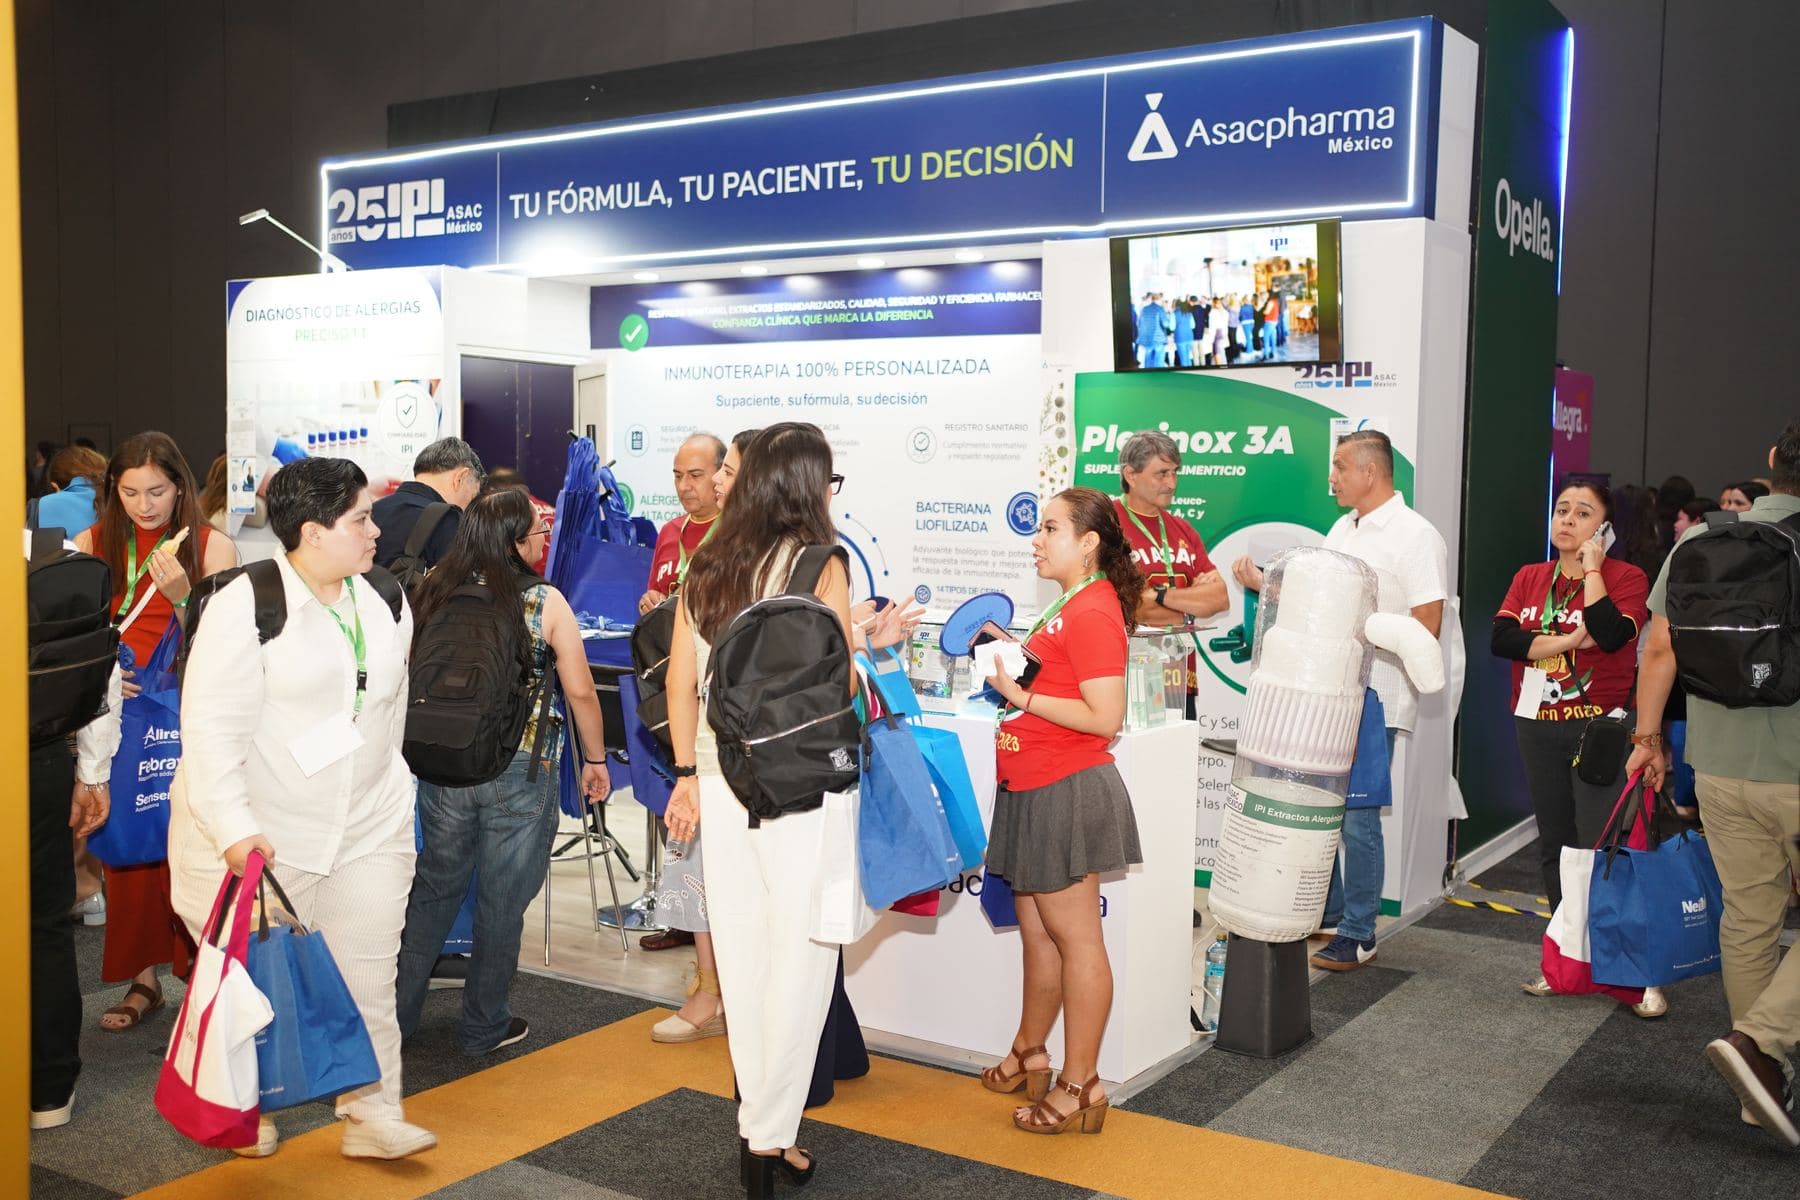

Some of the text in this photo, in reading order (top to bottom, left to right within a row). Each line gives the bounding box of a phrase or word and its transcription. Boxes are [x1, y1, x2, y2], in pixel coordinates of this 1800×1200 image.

[1185, 105, 1396, 149] Asacpharma
[1328, 135, 1394, 155] México
[509, 132, 1074, 220] TU FÓRMULA, TU PACIENTE, TU DECISIÓN
[446, 203, 483, 220] ASAC
[446, 220, 483, 235] México
[939, 295, 946, 304] Y
[335, 304, 351, 318] DE
[354, 299, 422, 315] ALERGIAS
[803, 313, 823, 326] QUE
[824, 310, 859, 324] MARCA
[860, 311, 874, 322] LA
[875, 309, 934, 321] DIFERENCIA
[664, 358, 991, 381] INMUNOTERAPIA 100% PERSONALIZADA
[822, 423, 841, 431] ACIA
[1554, 399, 1583, 441] llegra
[944, 423, 1029, 432] REGISTRO SANITARIO
[1243, 425, 1295, 455] 3A
[401, 444, 413, 453] IPI
[1084, 463, 1122, 475] SUPLE
[916, 501, 992, 515] BACTERIANA
[1187, 508, 1196, 518] C
[1196, 511, 1205, 520] y
[916, 519, 989, 533] LIOFILIZADA
[1009, 550, 1034, 558] poten
[913, 566, 940, 574] eficacia
[954, 568, 962, 576] la
[1210, 718, 1218, 731] y
[1220, 716, 1240, 730] Sel
[1198, 755, 1227, 769] erpo.
[1204, 796, 1221, 810] las
[1254, 803, 1266, 814] IPI
[1267, 807, 1311, 823] Extractos
[1195, 835, 1221, 849] ontr
